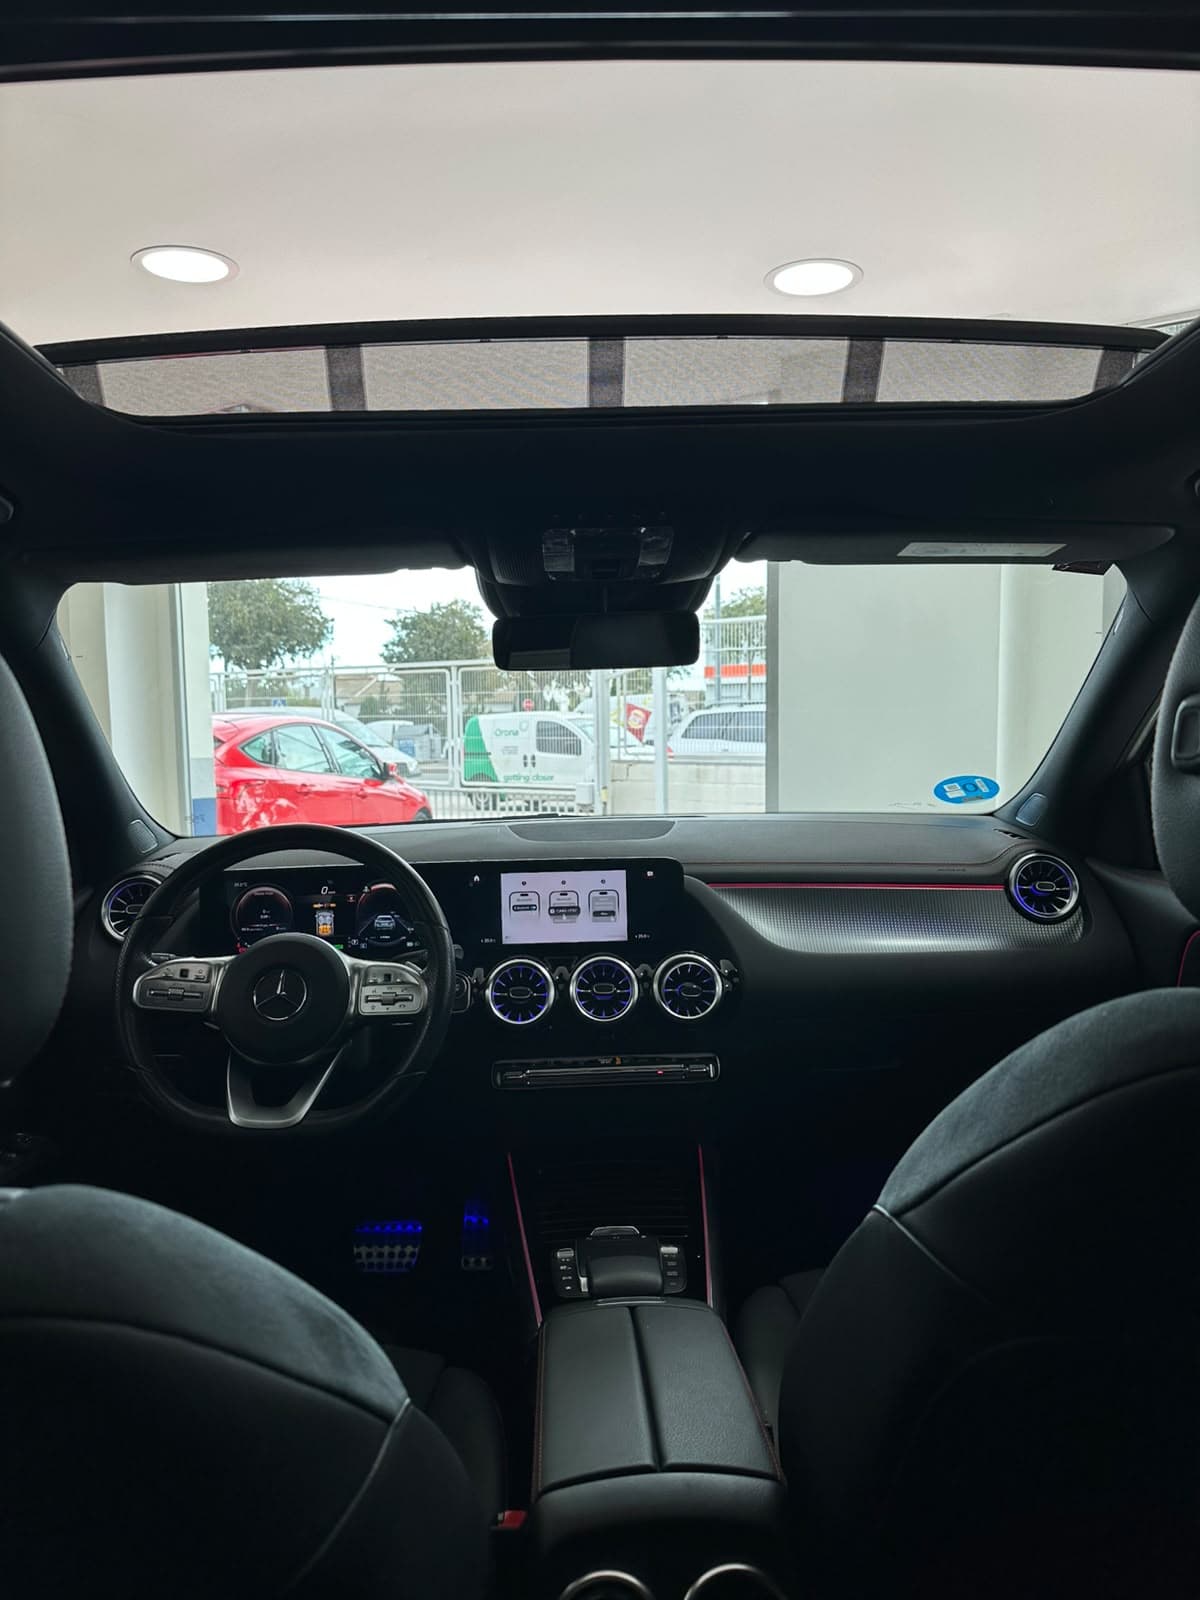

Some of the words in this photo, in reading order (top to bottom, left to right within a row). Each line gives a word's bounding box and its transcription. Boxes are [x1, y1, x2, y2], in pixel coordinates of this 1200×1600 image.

[495, 728, 519, 737] Orona
[503, 773, 530, 782] getting
[532, 773, 554, 781] closer
[321, 886, 329, 895] 0
